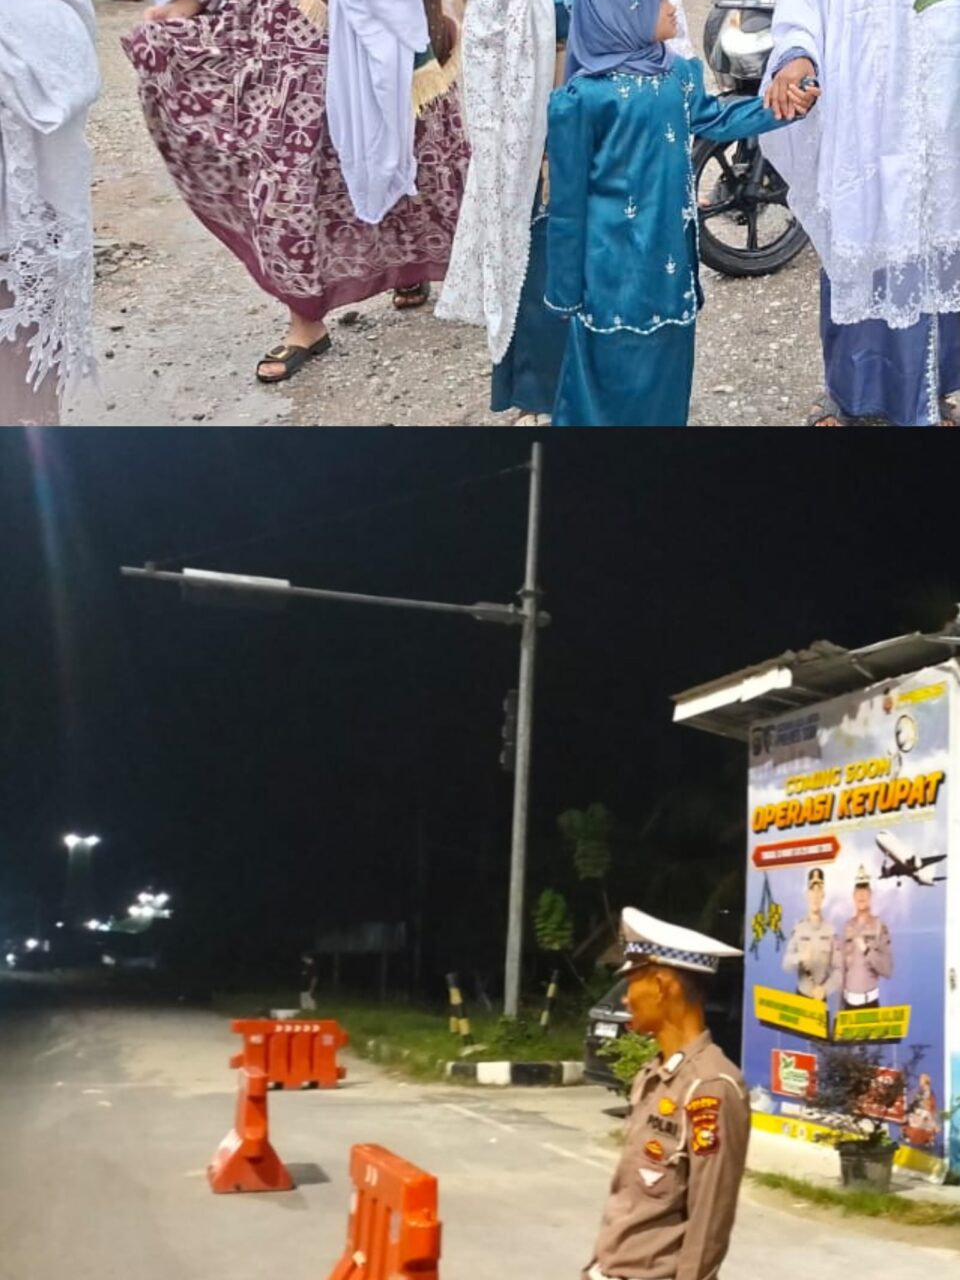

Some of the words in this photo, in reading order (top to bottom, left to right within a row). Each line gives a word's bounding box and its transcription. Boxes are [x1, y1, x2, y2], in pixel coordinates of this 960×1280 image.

[844, 756, 892, 784] SOON
[751, 792, 836, 834] OPERASI
[837, 769, 946, 820] KETUPAT
